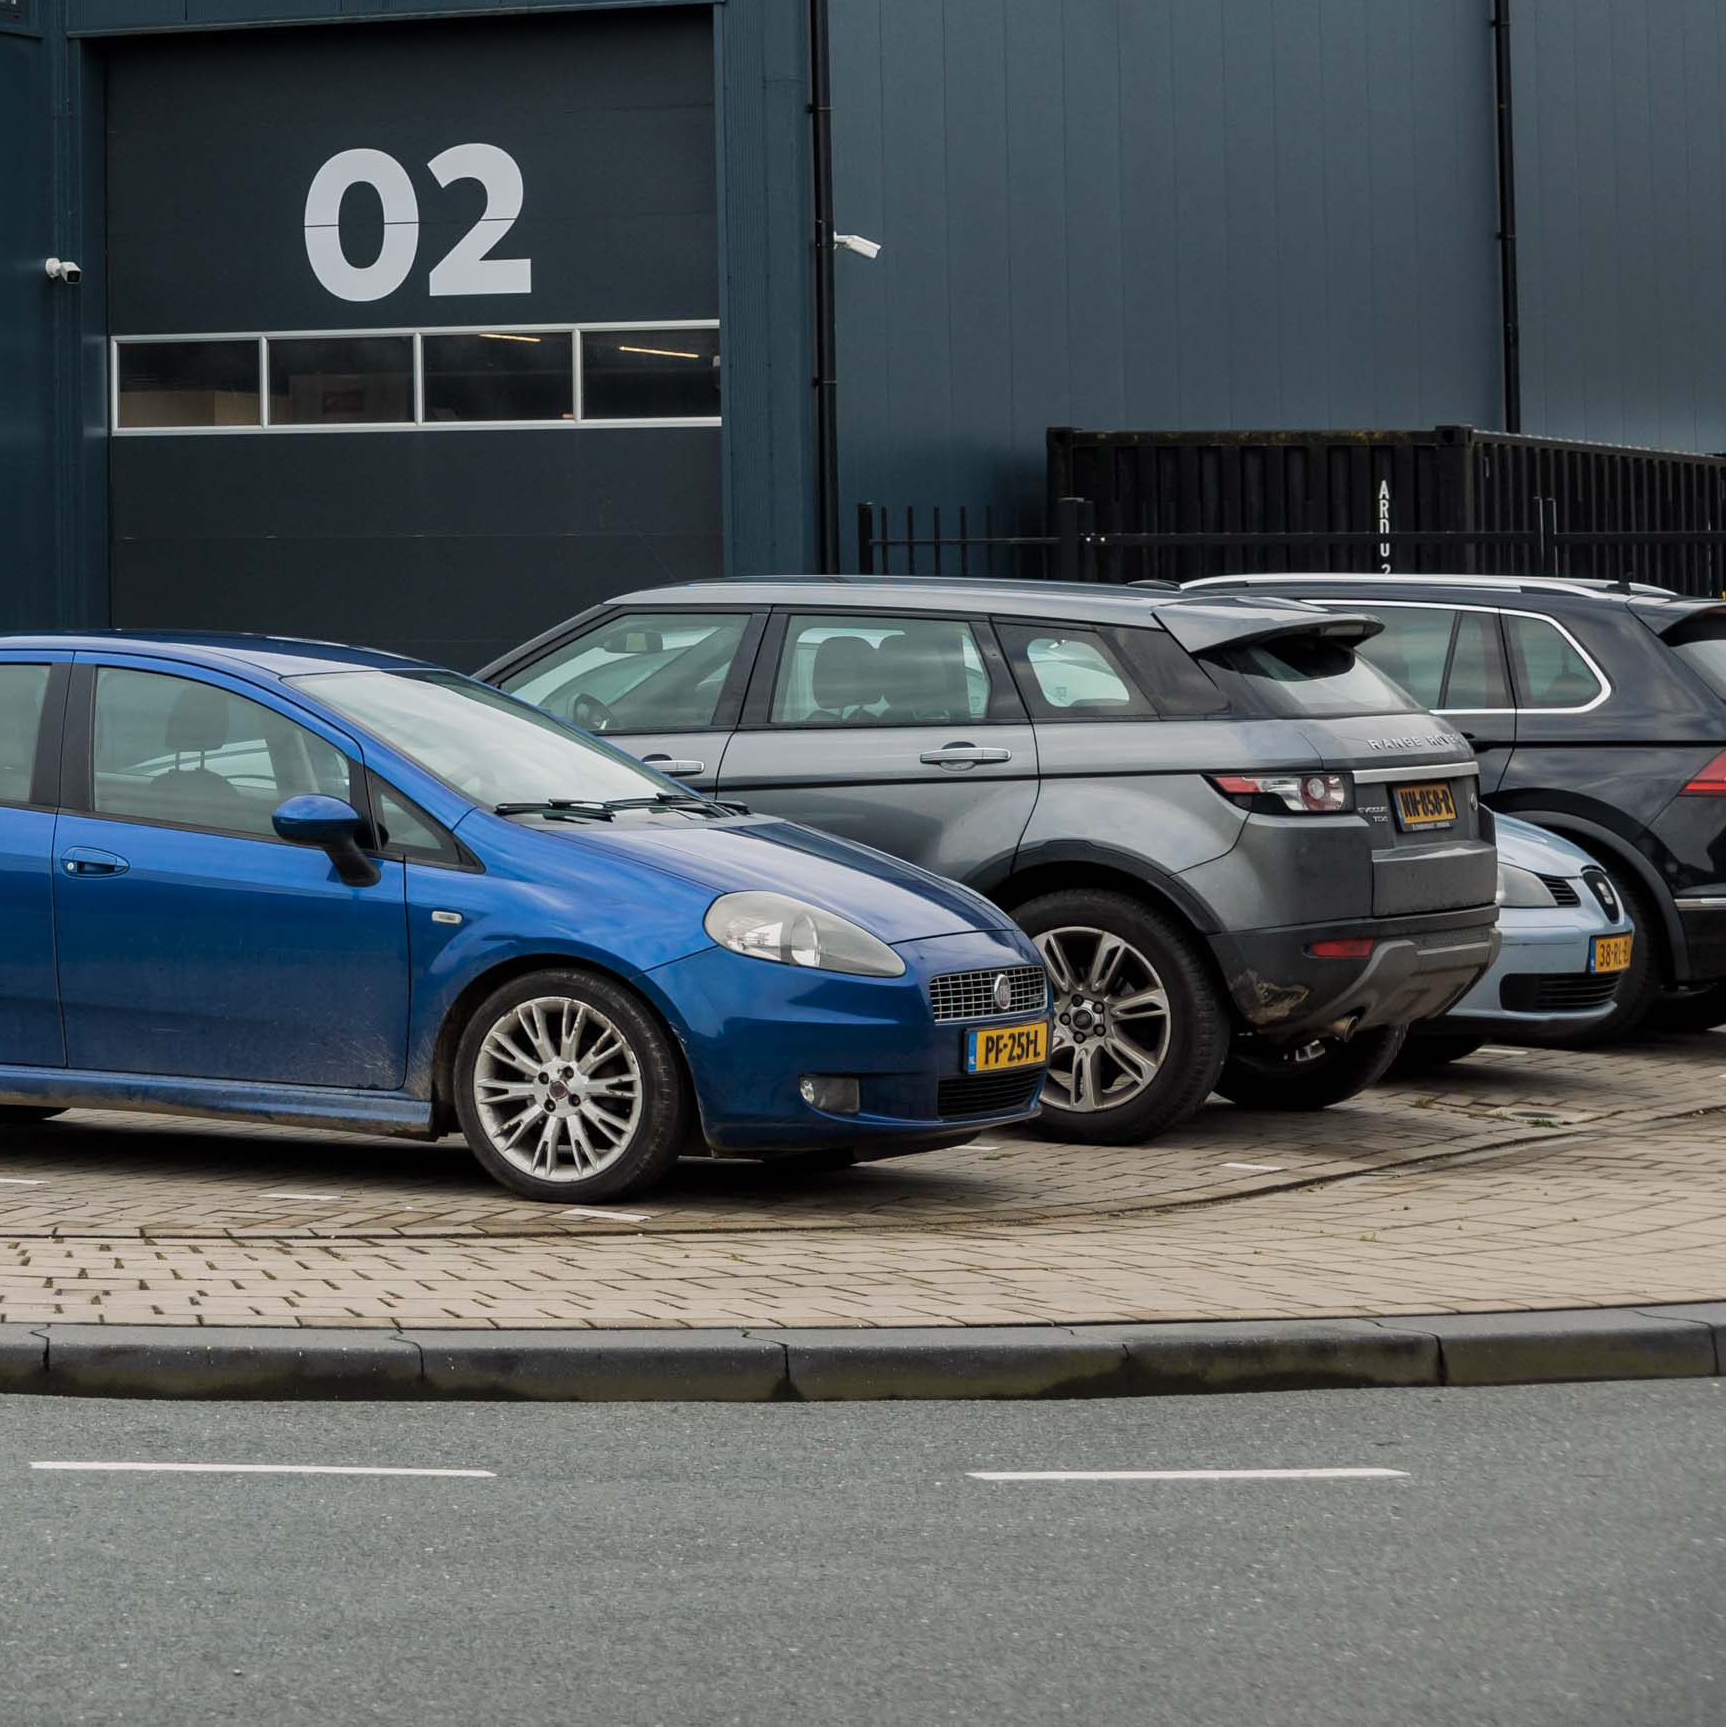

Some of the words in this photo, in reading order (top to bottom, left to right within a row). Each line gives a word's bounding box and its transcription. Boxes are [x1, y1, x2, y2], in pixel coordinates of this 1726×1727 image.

[303, 143, 533, 302] 02
[1368, 736, 1422, 751] RANGE
[984, 1029, 1042, 1065] PF-251-L
